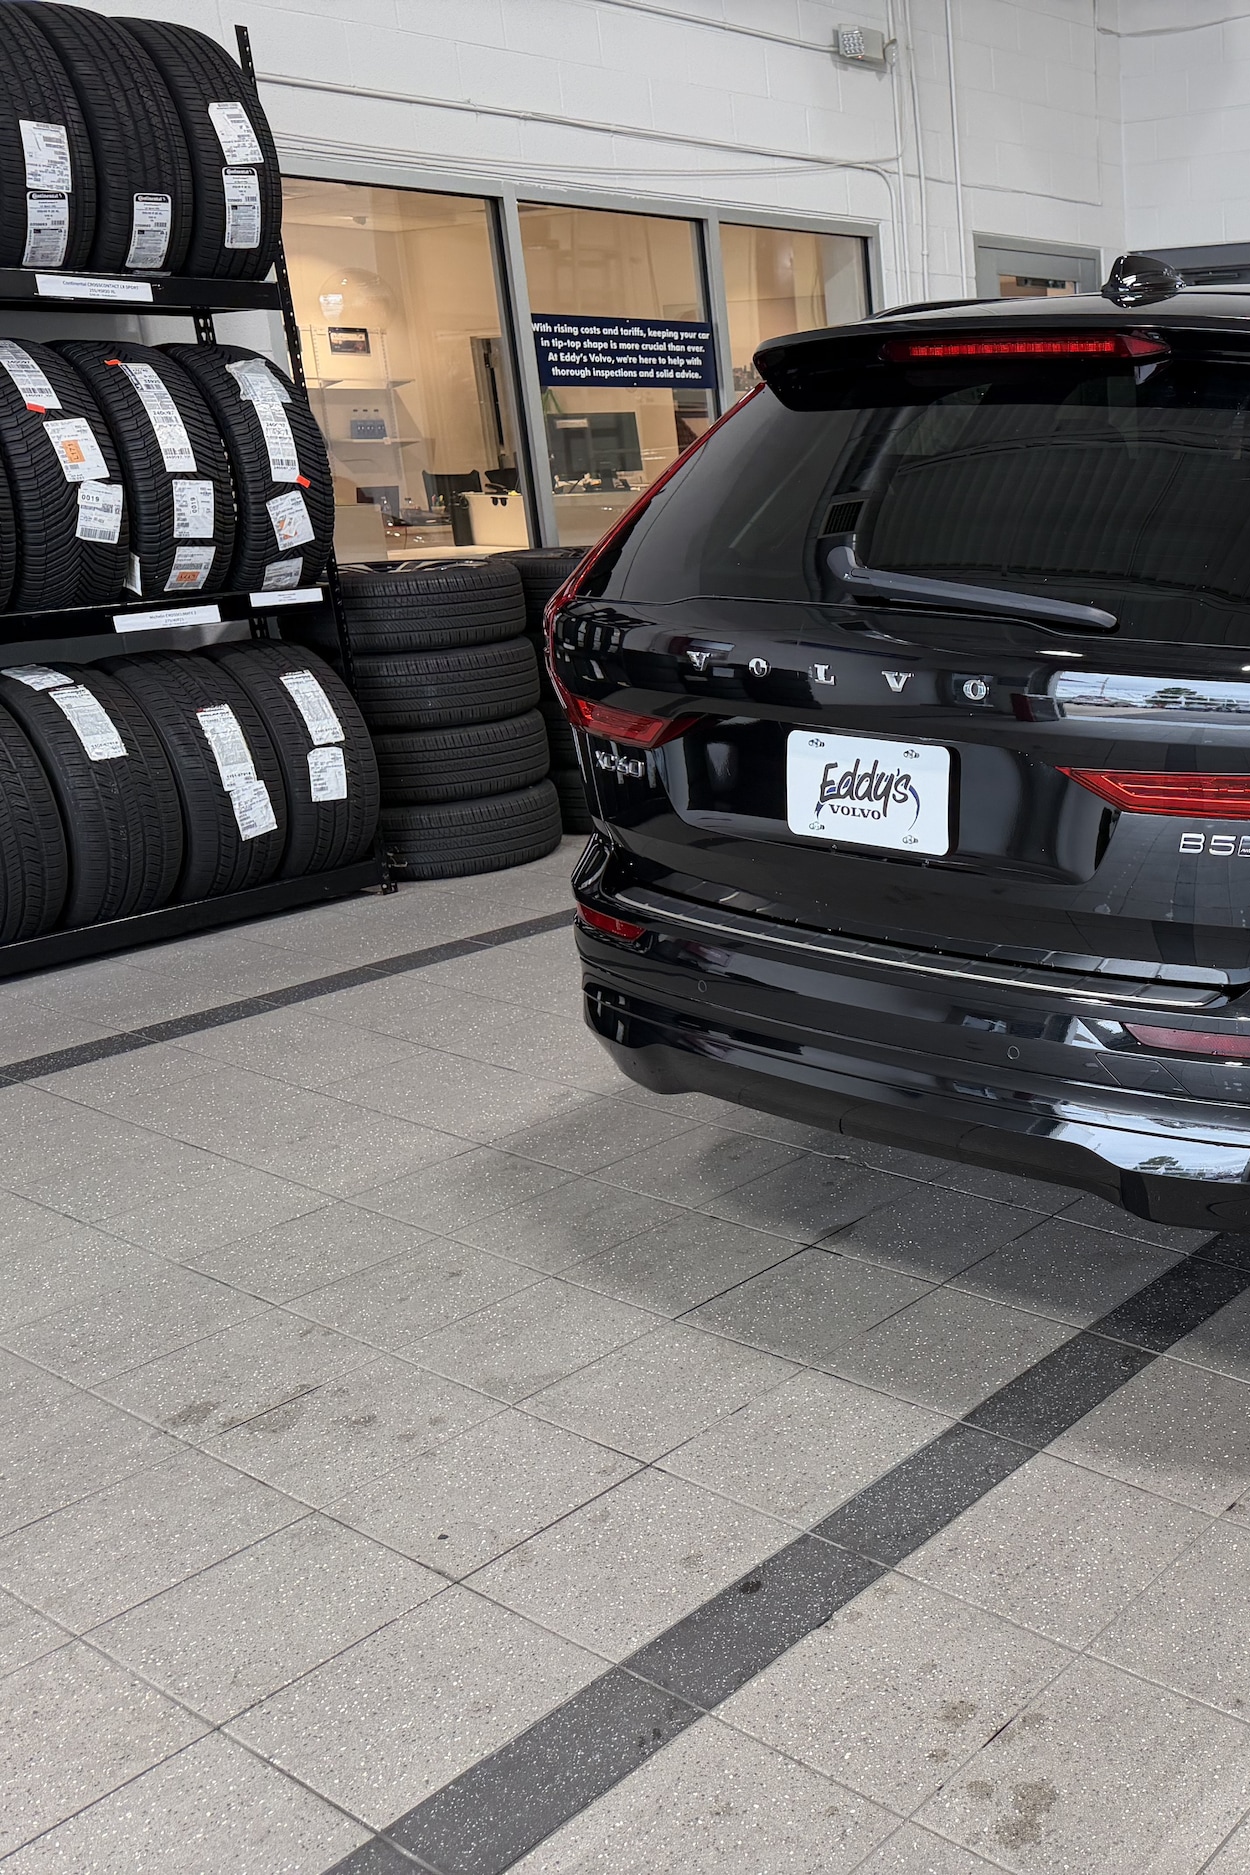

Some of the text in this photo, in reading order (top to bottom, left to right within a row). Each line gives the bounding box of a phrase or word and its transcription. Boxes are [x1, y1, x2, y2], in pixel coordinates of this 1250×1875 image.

[531, 322, 710, 341] With rising costs and tariffs, keeping your car
[541, 337, 705, 353] in tip-top shape is more crucial than ever.
[548, 352, 702, 367] At Eddy's Volvo, we're here to help with
[552, 366, 702, 380] thorough inspections and solid advice.
[81, 494, 100, 502] 0019
[686, 650, 990, 701] VOLVO
[595, 750, 645, 778] XC60
[819, 758, 912, 818] Eddy's
[829, 803, 881, 820] VOLVO
[1179, 832, 1237, 856] B5
